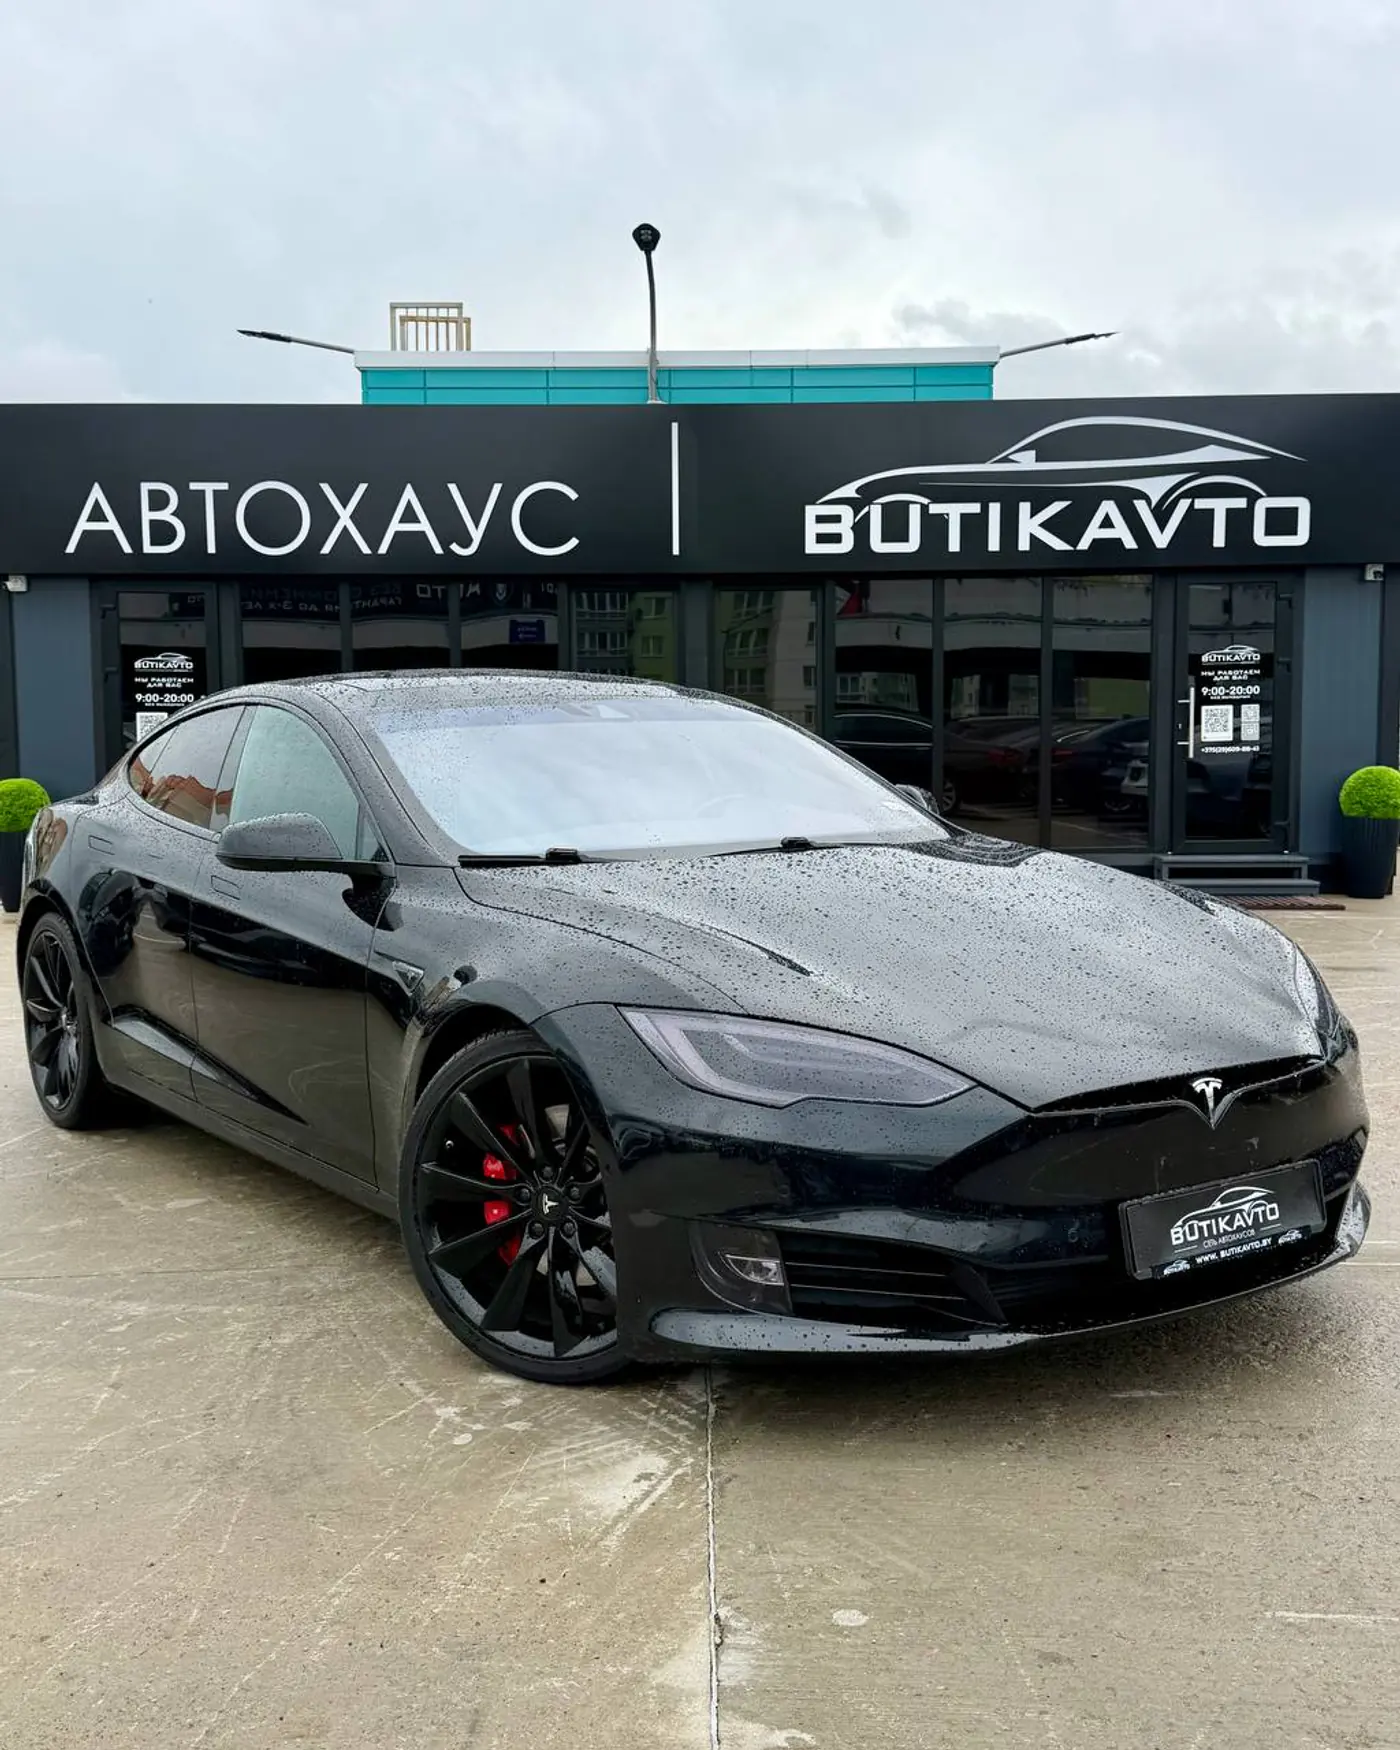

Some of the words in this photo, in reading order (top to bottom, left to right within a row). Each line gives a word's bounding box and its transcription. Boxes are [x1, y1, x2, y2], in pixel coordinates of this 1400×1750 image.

[65, 480, 580, 557] АВТОХАУС
[804, 496, 1311, 555] BUTIKAVTO
[1201, 653, 1260, 661] BUTIKAVTO
[135, 693, 194, 702] 9:00-20:00
[1201, 685, 1260, 695] 9:00-20:00
[1170, 1203, 1280, 1246] BUTIKAVTO
